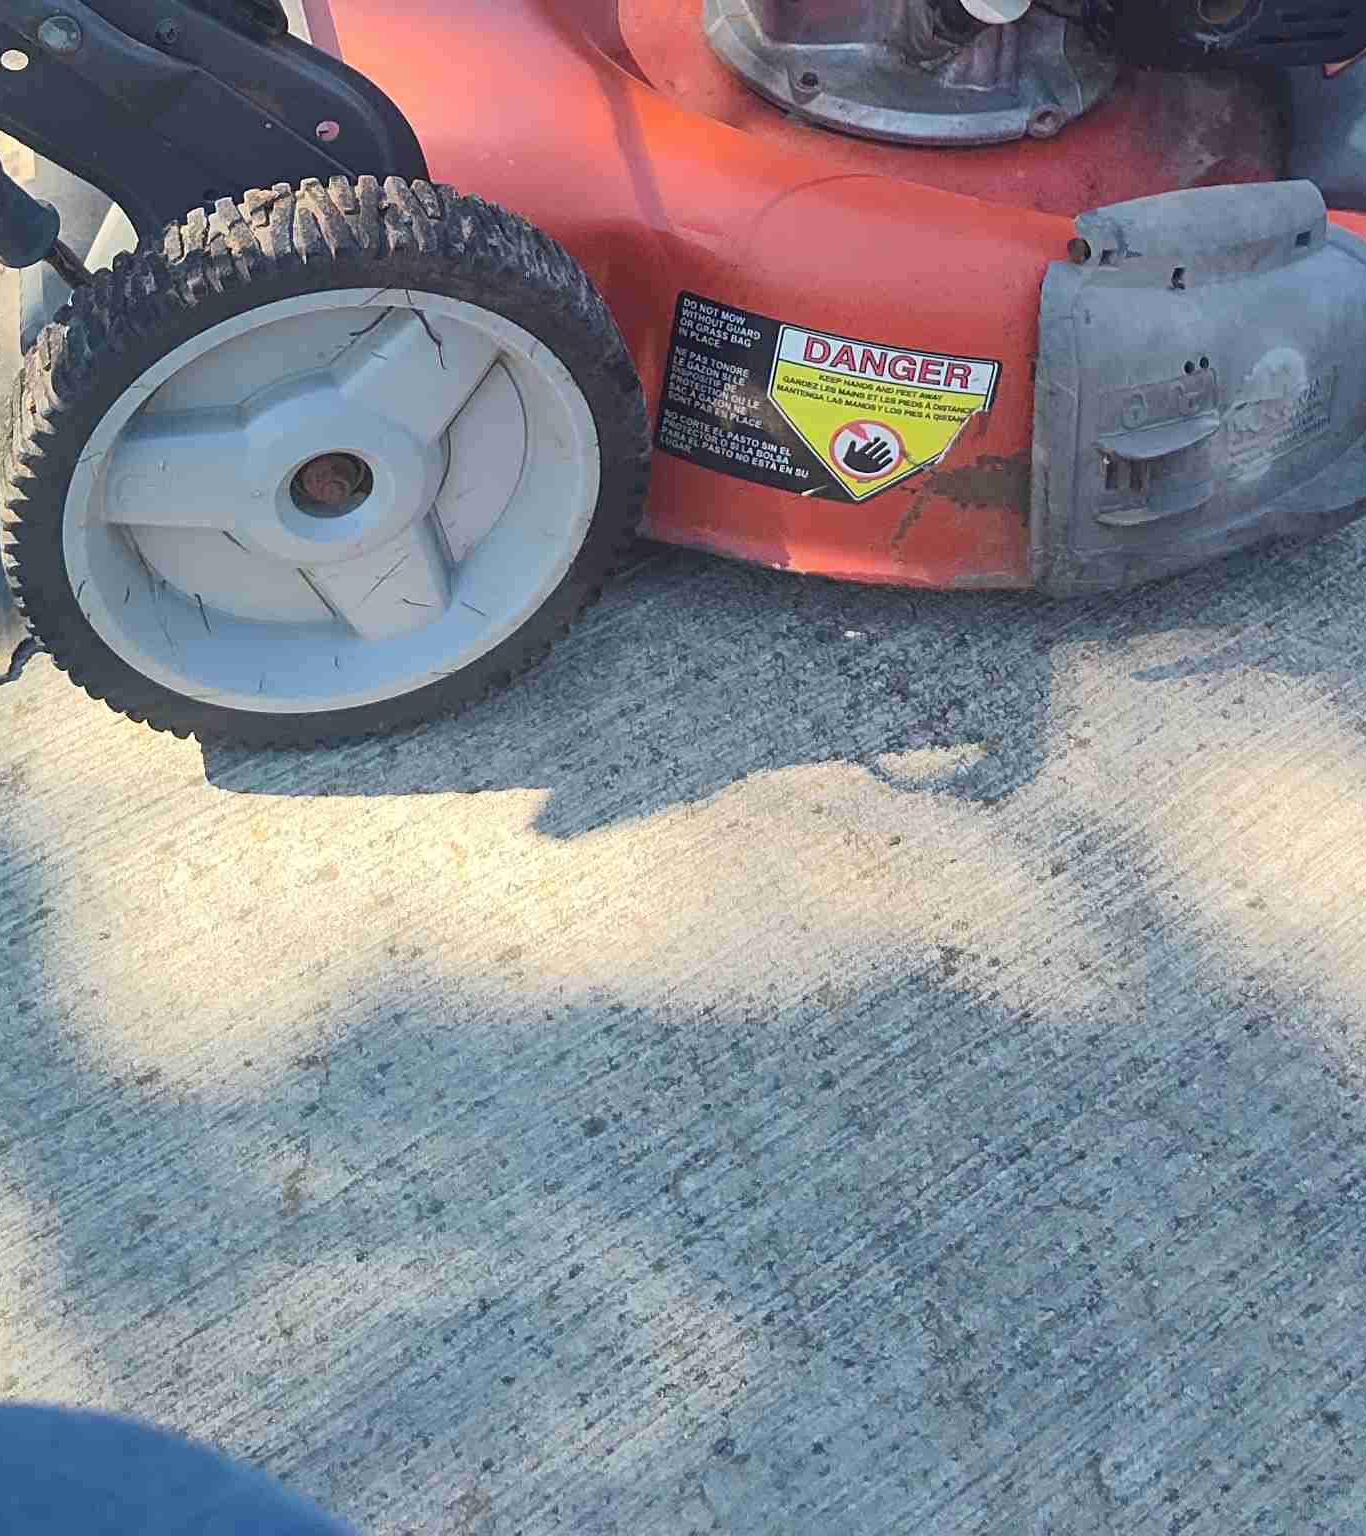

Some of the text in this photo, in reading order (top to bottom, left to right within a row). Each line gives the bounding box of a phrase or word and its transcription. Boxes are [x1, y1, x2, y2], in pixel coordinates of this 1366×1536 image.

[682, 308, 761, 340] WITHOUT GUARD
[683, 298, 746, 325] DO NOT MOW
[678, 326, 722, 349] IN PLACE
[680, 317, 752, 348] OR GRASS BAG
[675, 345, 750, 378] NE PAS TONDRE
[686, 361, 720, 378] GAZON
[732, 374, 746, 386] LE
[803, 335, 973, 390] DANGER
[724, 382, 737, 394] DE
[777, 384, 825, 401] MANTENGA
[826, 395, 843, 405] LAS
[844, 398, 876, 411] MANOS
[884, 406, 902, 415] LOS
[903, 409, 924, 418] PIES
[818, 375, 944, 401] KEEP HANDS AND FEET AWAY
[838, 387, 866, 399] MAINS
[867, 392, 878, 401] ET
[880, 396, 896, 405] LES
[897, 398, 923, 408] PIEDS
[698, 393, 732, 411] GAZON
[734, 405, 747, 416] NE
[730, 394, 746, 405] OU
[746, 398, 760, 409] LE
[730, 413, 763, 430] PLACE
[680, 415, 710, 432] CORTE
[713, 426, 725, 438] EL
[727, 431, 760, 447] PASTO
[761, 441, 777, 453] SIN
[779, 446, 793, 457] EL
[702, 441, 734, 458] PASTO
[735, 451, 750, 463] NO
[778, 464, 793, 475] EN
[795, 468, 809, 479] SU
[741, 444, 754, 455] LA
[756, 448, 790, 464] BOLSA
